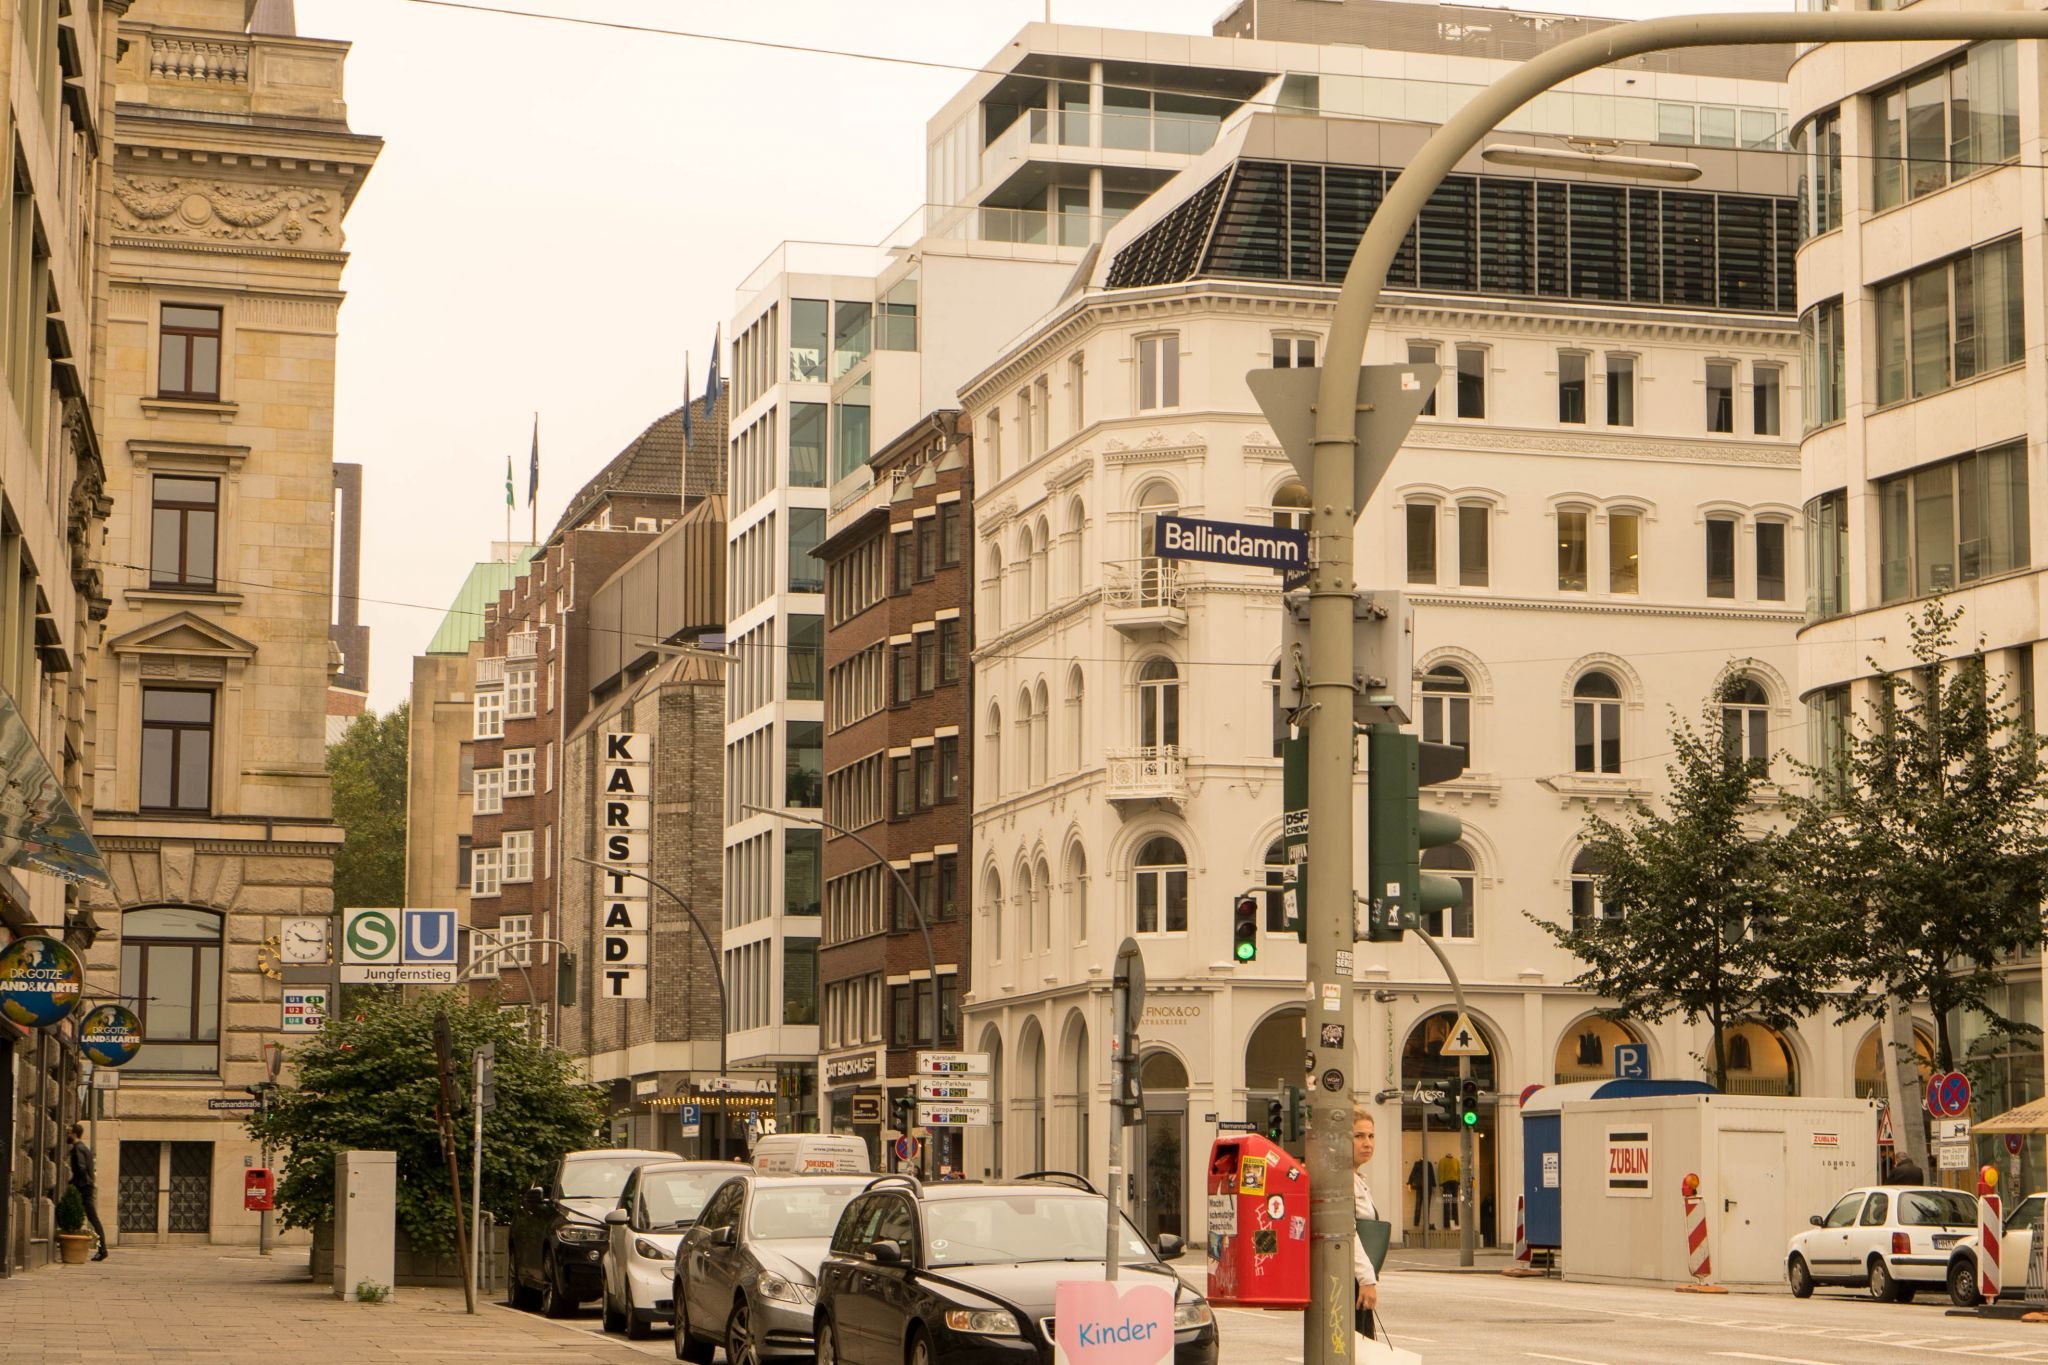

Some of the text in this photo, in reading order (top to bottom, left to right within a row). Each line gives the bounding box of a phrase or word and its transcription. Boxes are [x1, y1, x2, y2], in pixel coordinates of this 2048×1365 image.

[1165, 522, 1299, 562] Ballindamm
[1285, 811, 1308, 826] DSF
[1286, 824, 1308, 836] CREW
[605, 734, 634, 997] KARSTADT
[355, 916, 388, 956] S
[412, 914, 448, 957] U
[364, 968, 451, 982] Jungfernstieg
[837, 1059, 868, 1076] BACKHUS
[210, 1100, 260, 1108] Ferdinandstraße
[955, 1107, 980, 1115] Passage
[1078, 1317, 1158, 1347] Kinder
